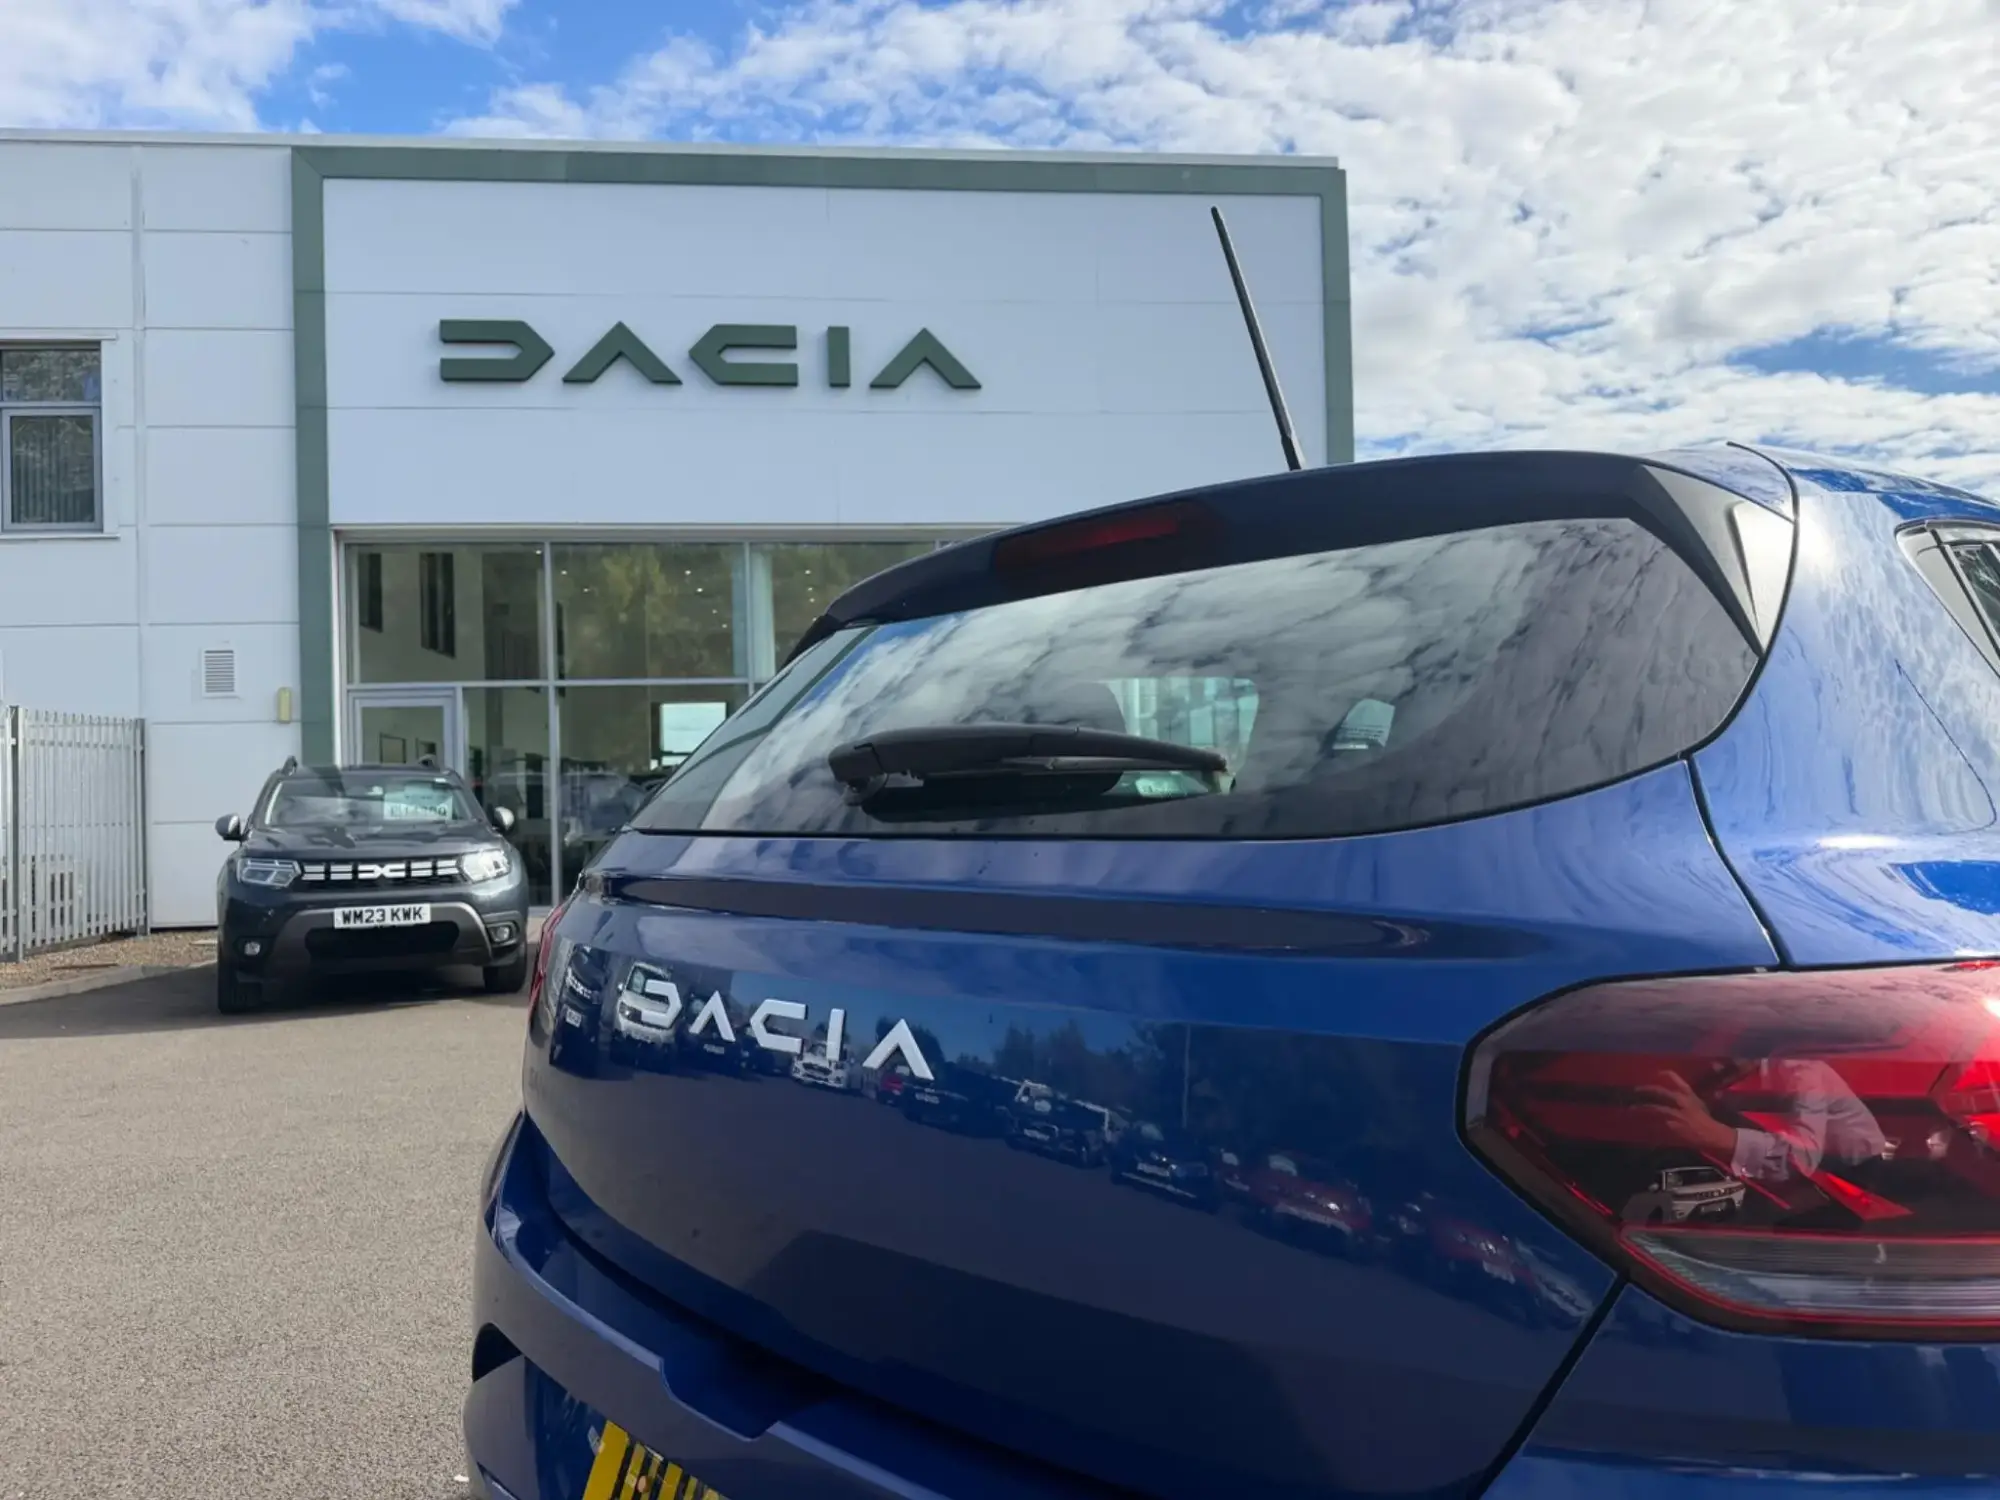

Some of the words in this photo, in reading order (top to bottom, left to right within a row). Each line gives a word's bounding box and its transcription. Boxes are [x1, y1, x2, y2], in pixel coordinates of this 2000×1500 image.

[439, 319, 982, 389] DACIA
[342, 909, 386, 925] WM23
[390, 906, 423, 922] KWK
[641, 978, 935, 1081] DACIA
